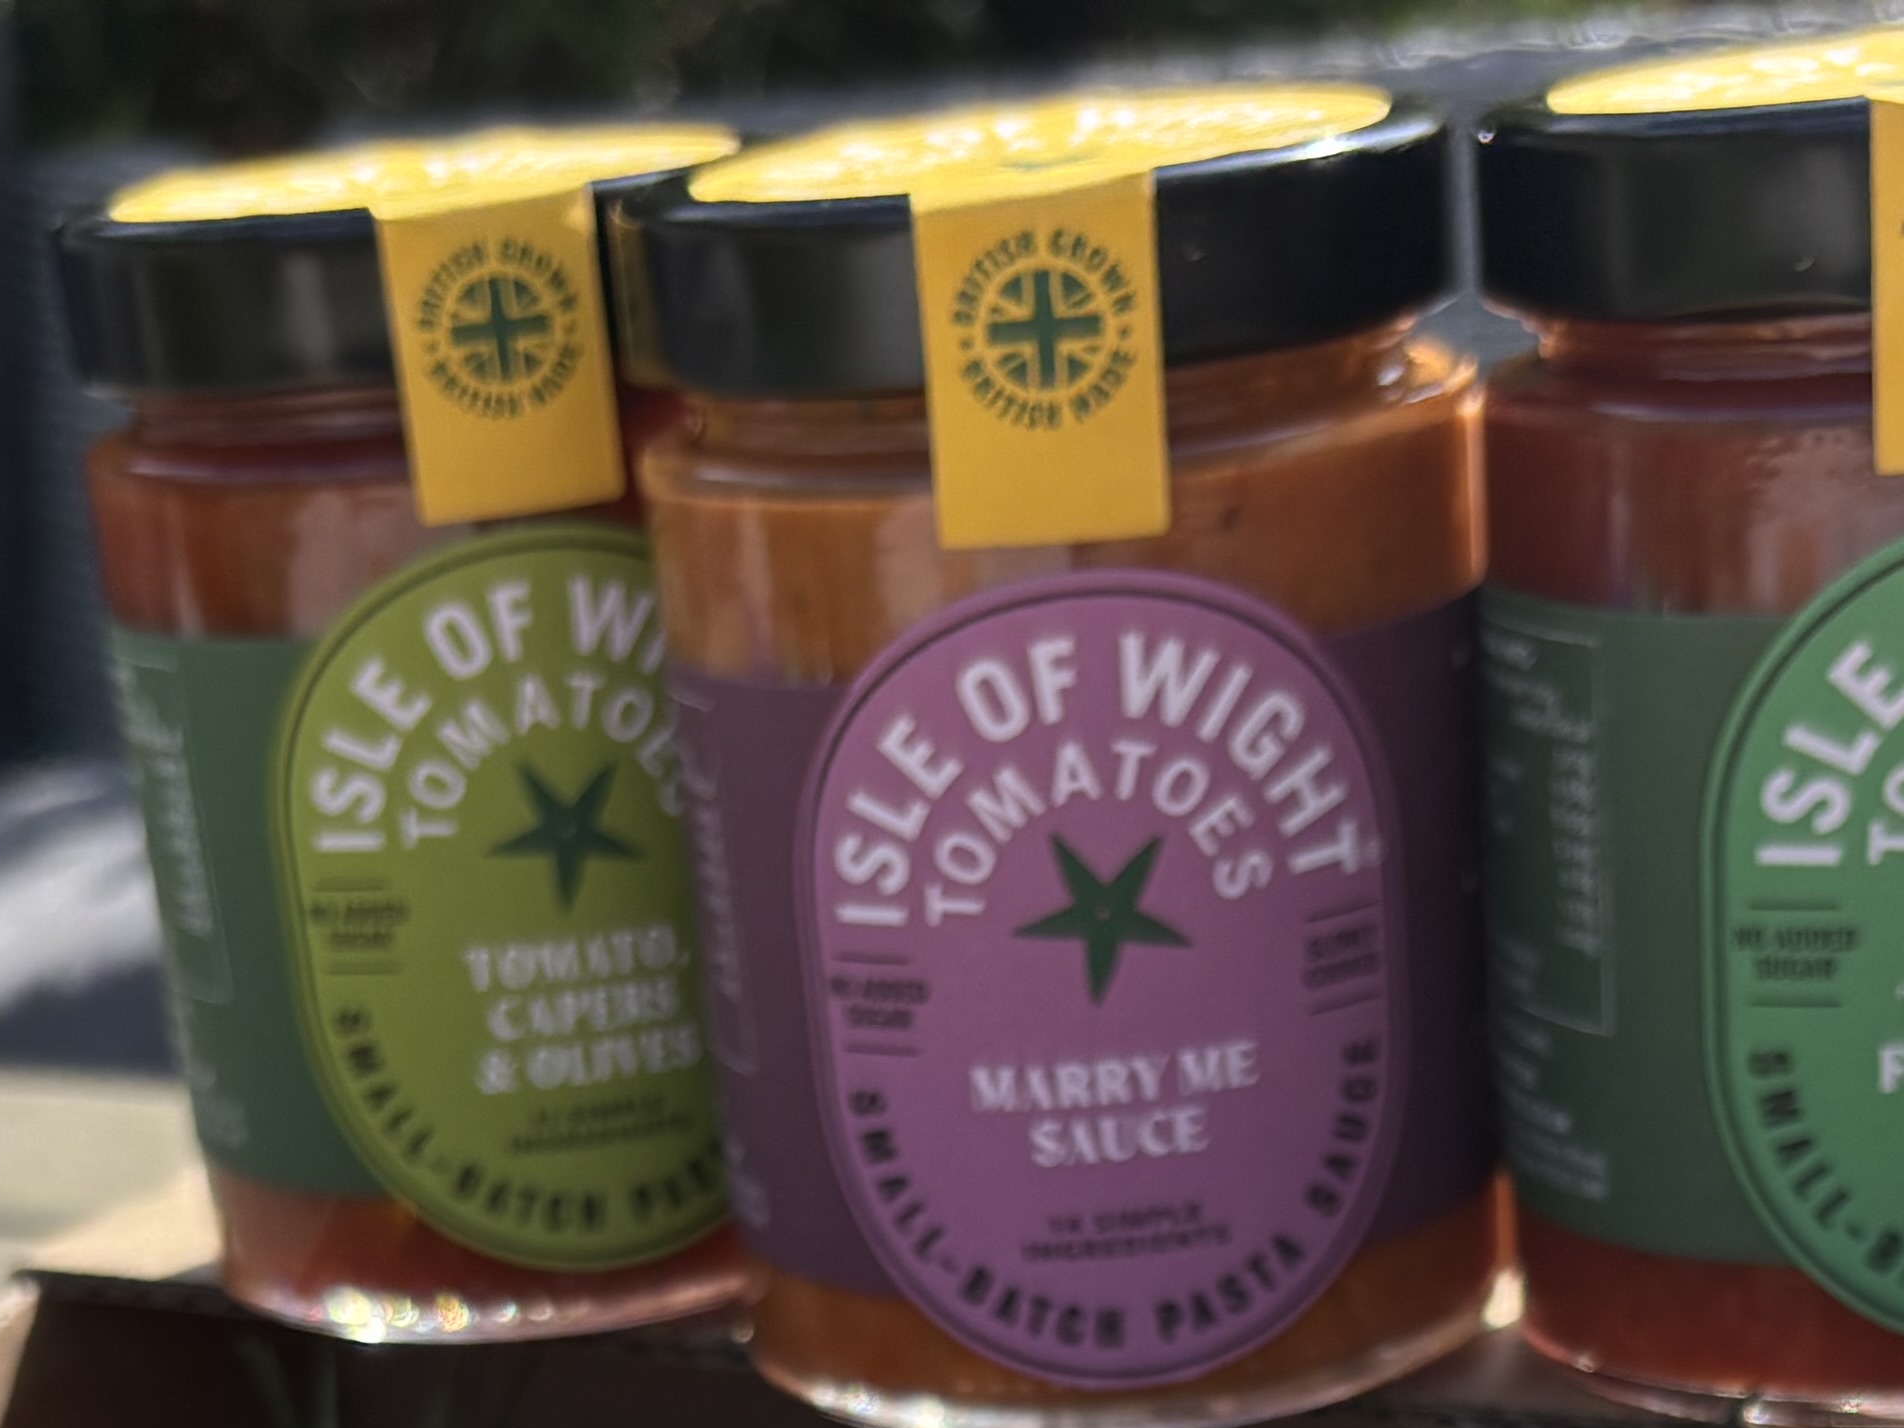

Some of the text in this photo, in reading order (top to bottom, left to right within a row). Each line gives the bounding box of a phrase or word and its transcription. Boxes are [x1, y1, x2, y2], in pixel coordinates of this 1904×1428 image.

[312, 656, 432, 852] ISLE
[423, 580, 533, 679] OF
[834, 712, 964, 927] ISLE
[955, 636, 1077, 743] OF
[1118, 630, 1363, 875] WIGHT
[924, 740, 1273, 927] TOMATOES
[969, 1040, 1260, 1113] MARRY ME
[1029, 1105, 1210, 1167] SAUCE
